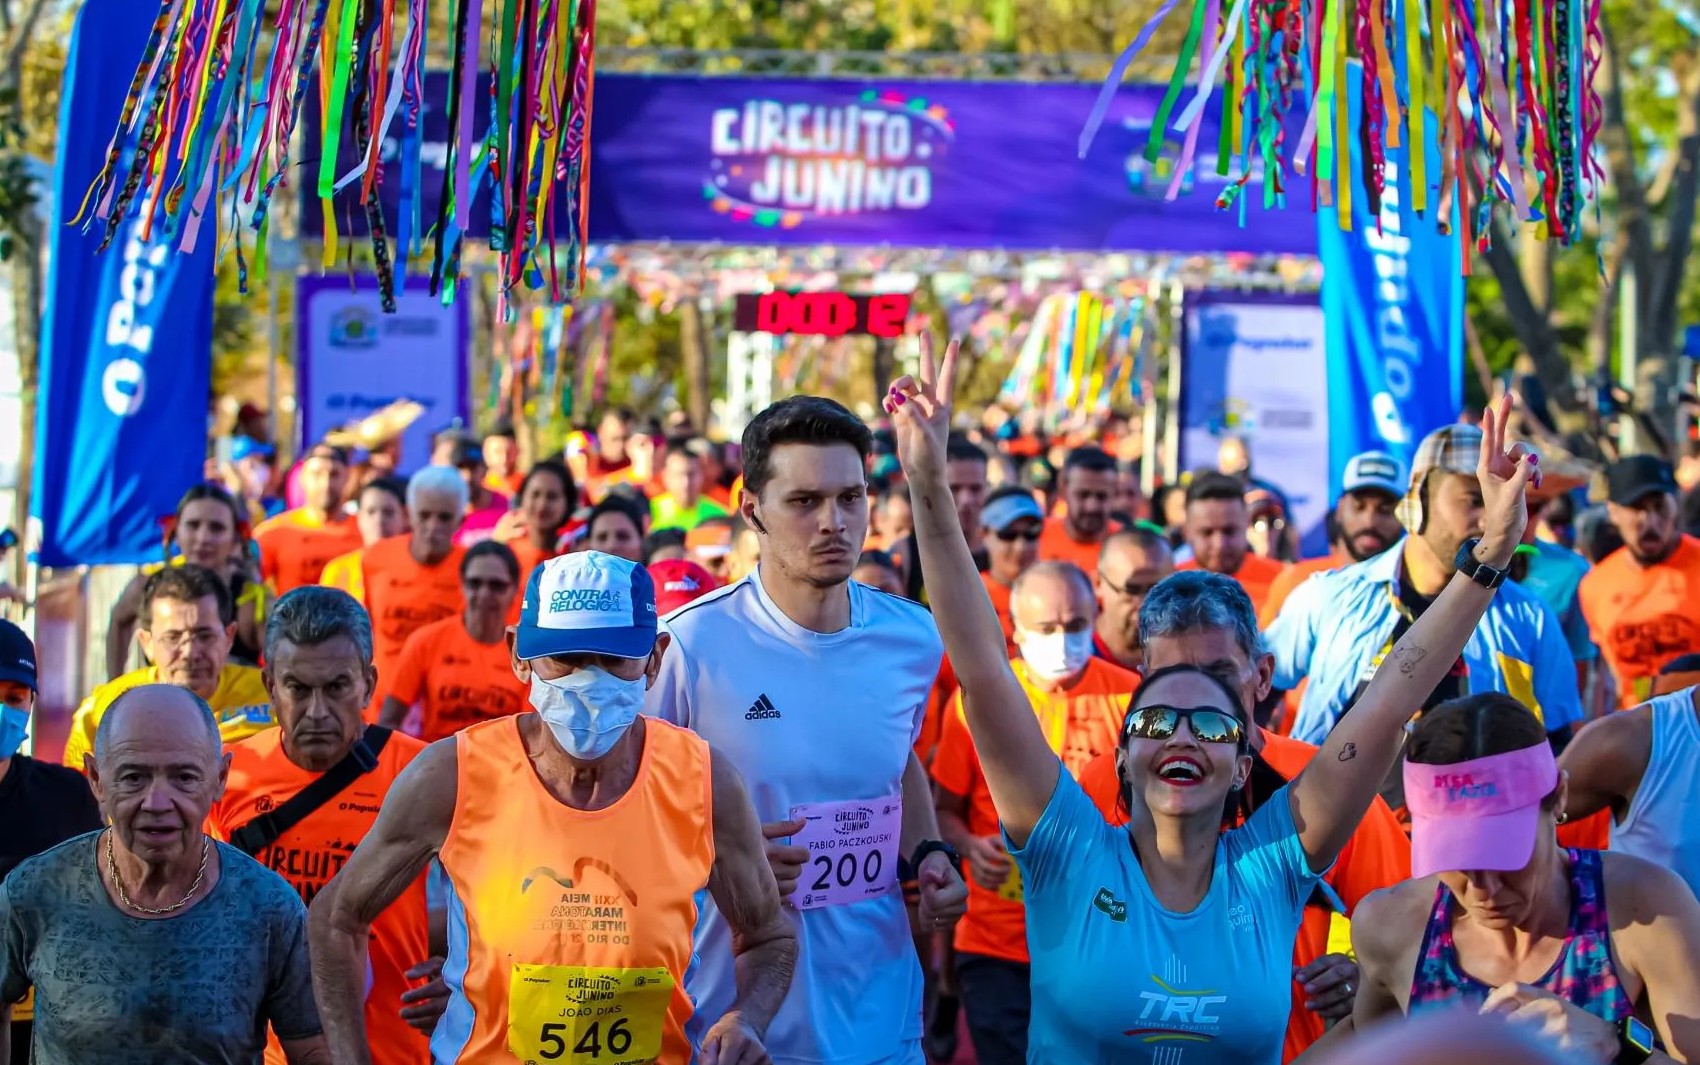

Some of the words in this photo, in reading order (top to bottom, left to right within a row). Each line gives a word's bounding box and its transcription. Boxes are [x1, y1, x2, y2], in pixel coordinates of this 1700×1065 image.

[711, 98, 911, 161] CIRCUITO
[750, 154, 932, 214] JUNINO
[551, 589, 612, 602] CONTRA
[549, 600, 611, 613] RELOGIO
[745, 710, 781, 720] adidas
[835, 811, 867, 822] CIRCUITO
[841, 821, 869, 831] JUNINO
[809, 840, 836, 850] FABIO
[838, 833, 892, 848] PACZKOUSKI
[264, 845, 347, 879] IRCUIT
[811, 849, 882, 890] 200
[568, 977, 612, 990] CIRCUITO
[576, 990, 615, 1000] JUNINO
[558, 1007, 592, 1018] JOAO
[596, 1004, 622, 1016] DIAS
[1139, 991, 1228, 1024] TRC
[539, 1017, 632, 1059] 546
